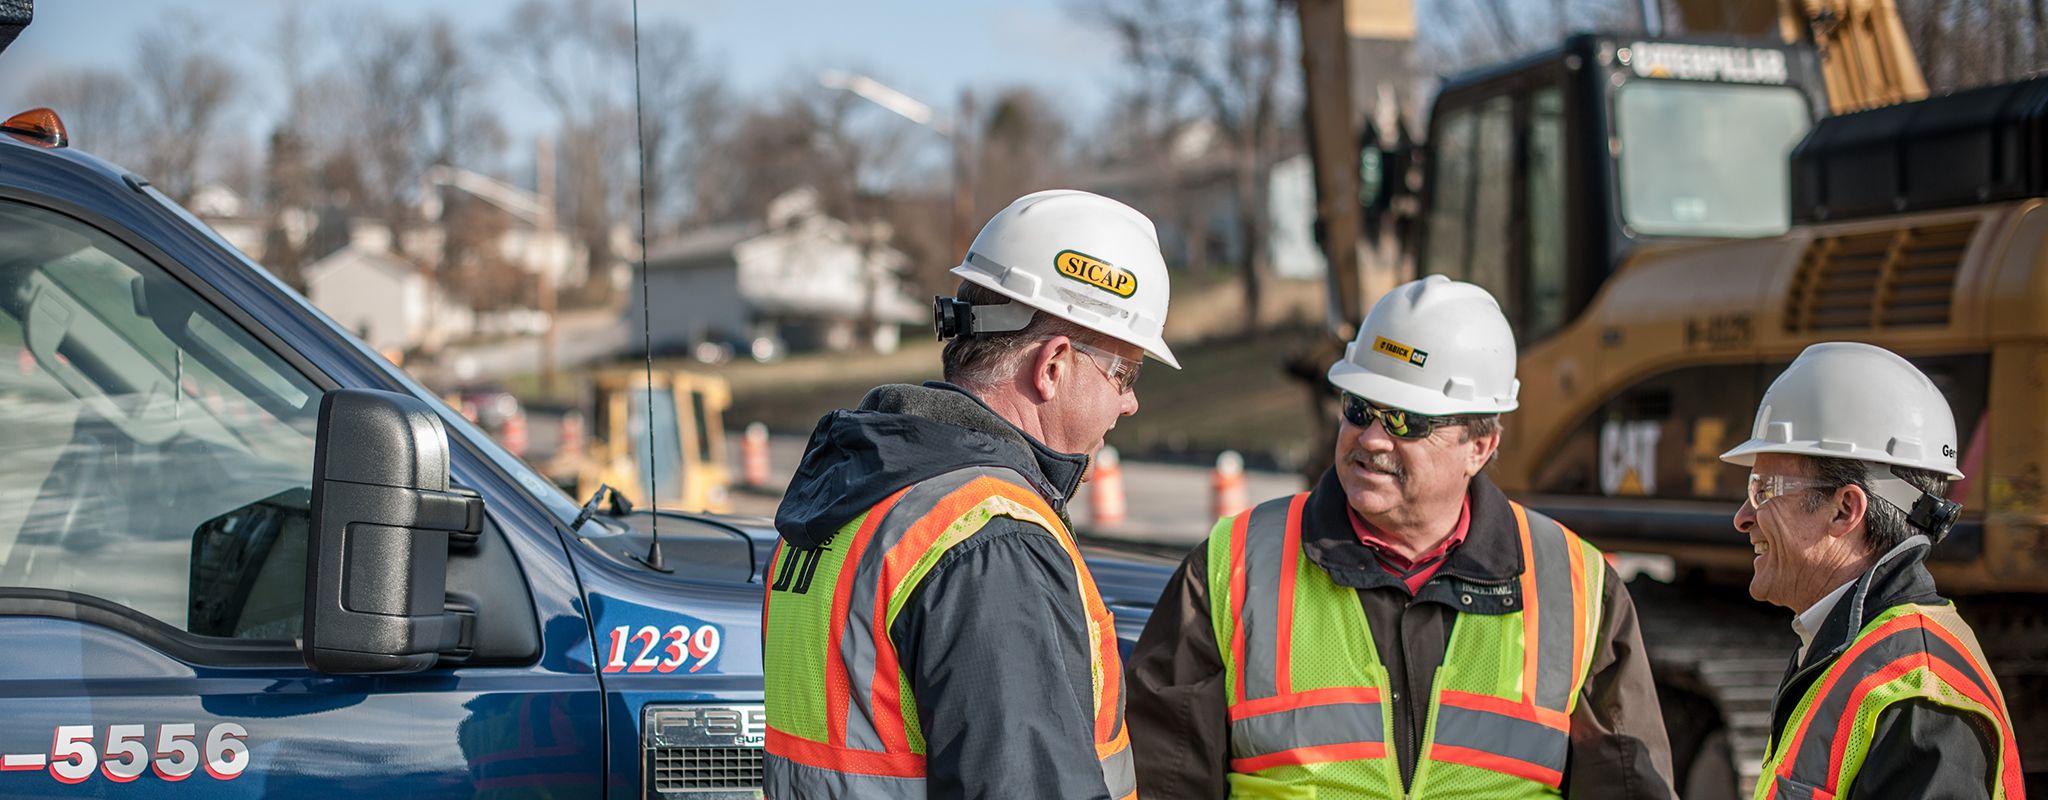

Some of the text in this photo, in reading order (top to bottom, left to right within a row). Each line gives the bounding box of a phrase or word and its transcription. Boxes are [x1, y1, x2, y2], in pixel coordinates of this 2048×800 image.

[1631, 41, 1788, 84] CATERPILLAR
[1066, 257, 1128, 290] SICAP
[1411, 352, 1426, 364] CAT
[1600, 419, 1661, 496] CAT
[602, 625, 720, 673] 1239
[0, 722, 250, 784] -5556
